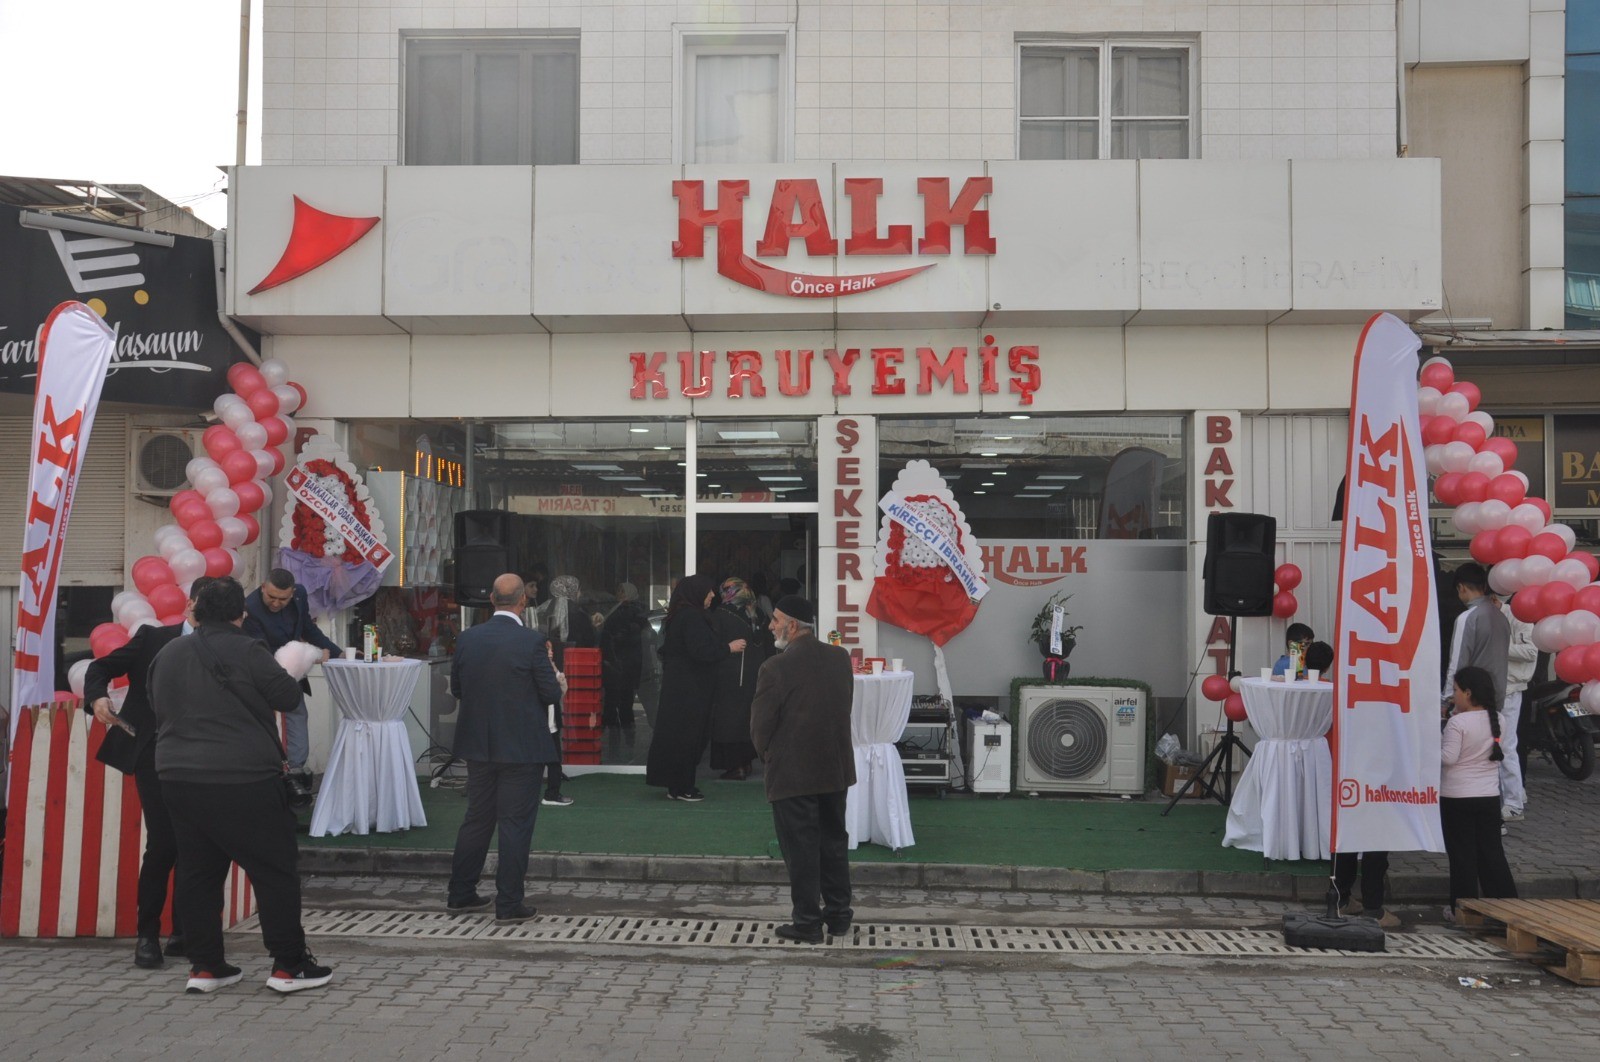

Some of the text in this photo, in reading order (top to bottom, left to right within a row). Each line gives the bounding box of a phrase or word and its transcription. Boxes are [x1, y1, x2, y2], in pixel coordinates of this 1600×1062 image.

[672, 177, 996, 259] HALK
[790, 276, 877, 294] Önce Halk
[629, 334, 1042, 406] KURUYEMİŞ
[299, 489, 369, 553] ÖZCAN ÇETİN
[303, 479, 376, 547] BAKKALLAR ODASI BAŞKANI
[1406, 489, 1425, 558] önce halk
[888, 503, 979, 596] KİREÇÇİ İBRAHİM
[979, 546, 1088, 573] HALK
[1347, 412, 1411, 714] HALK
[1114, 697, 1138, 706] airfel
[1365, 784, 1439, 805] halkoncehalk
